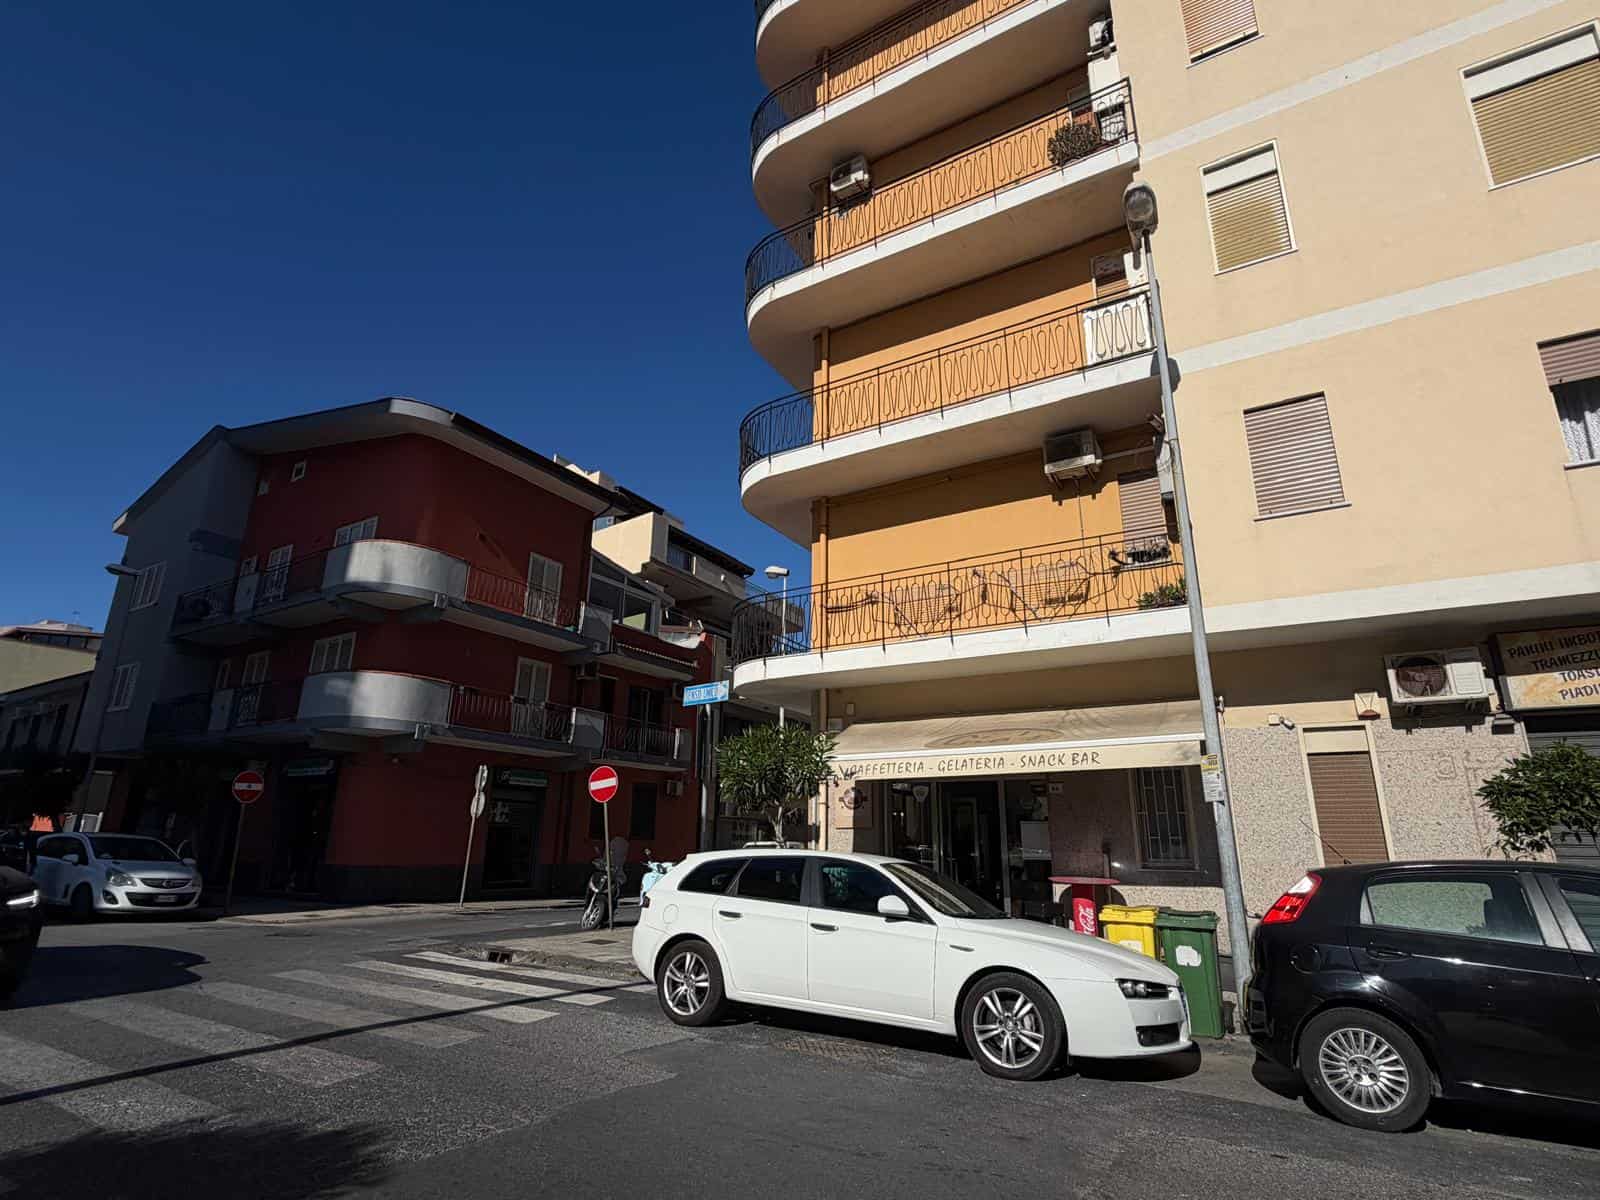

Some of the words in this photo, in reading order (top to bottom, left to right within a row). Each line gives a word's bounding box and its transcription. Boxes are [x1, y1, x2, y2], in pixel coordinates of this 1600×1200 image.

[1507, 640, 1555, 658] PANINI
[1558, 684, 1600, 700] PIADI
[938, 757, 1005, 773] GELATERIA
[1020, 753, 1066, 768] SNACK
[1071, 751, 1101, 766] BAR
